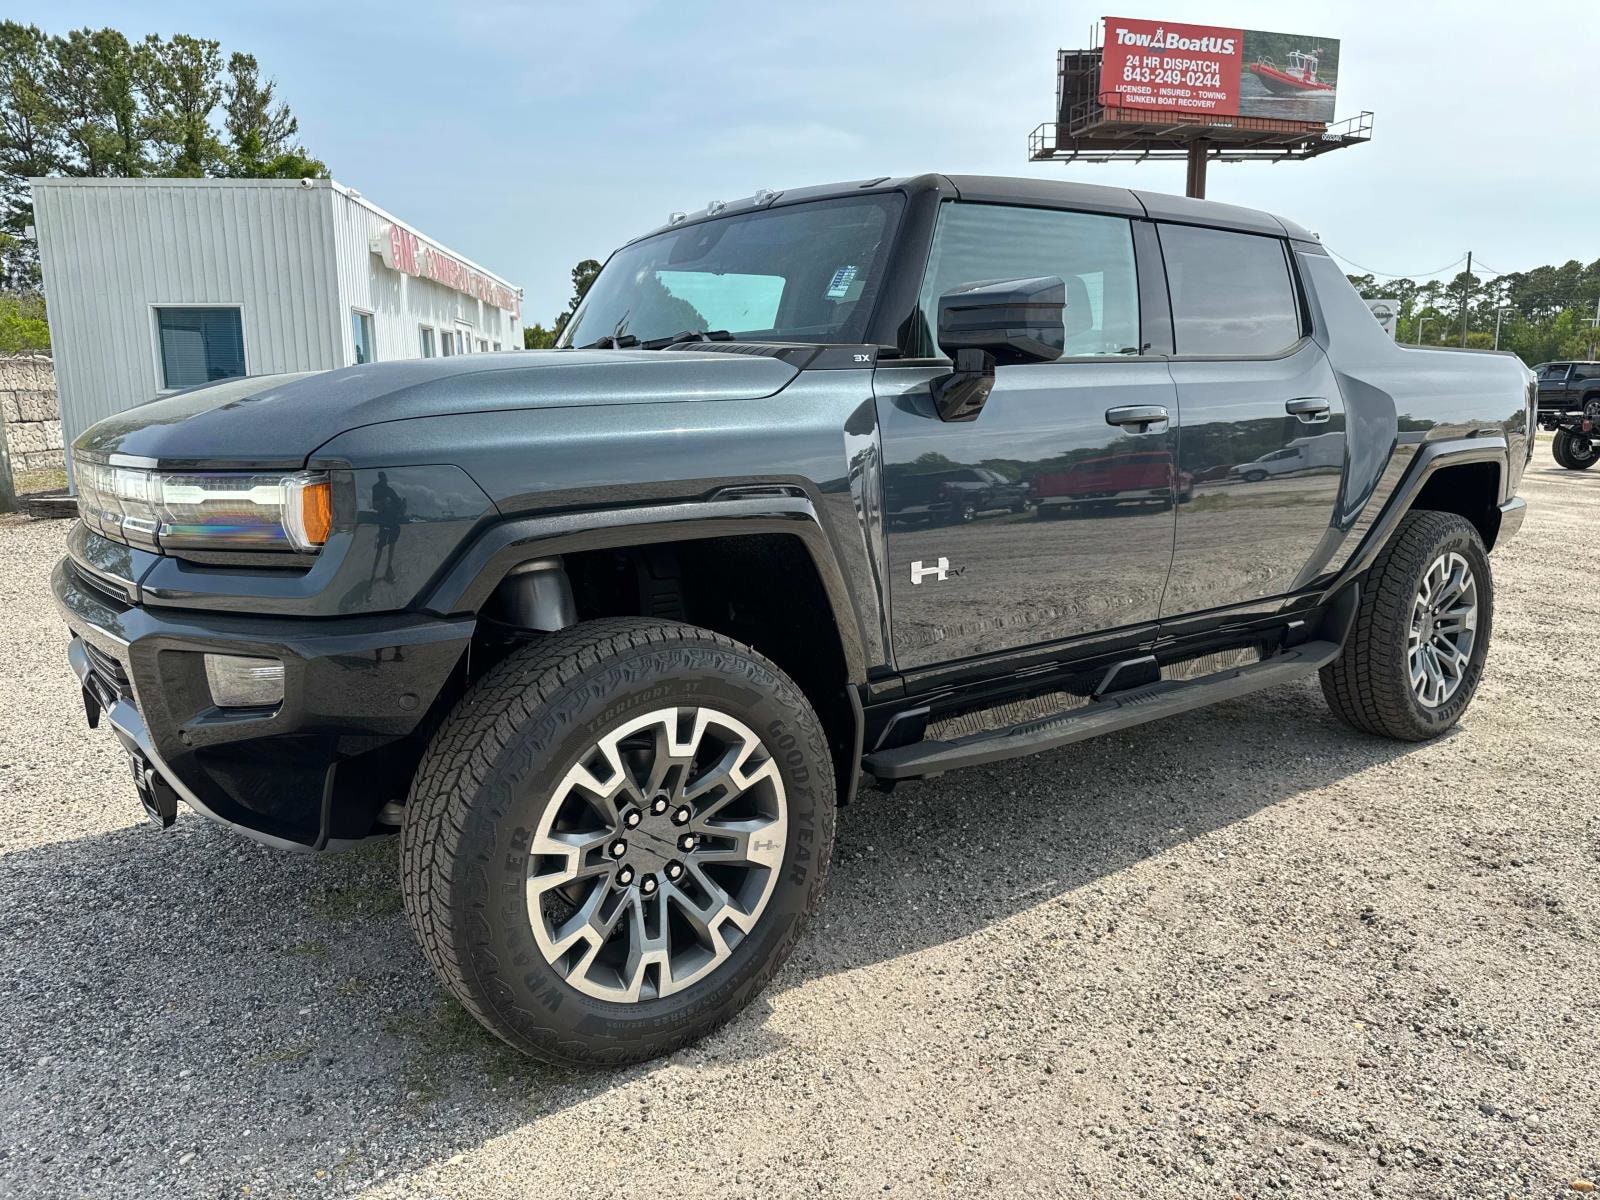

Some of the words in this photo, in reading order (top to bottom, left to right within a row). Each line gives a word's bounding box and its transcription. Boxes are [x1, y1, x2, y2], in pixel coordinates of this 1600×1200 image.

[1126, 55, 1140, 66] 24
[1143, 56, 1160, 69] HR
[1163, 58, 1219, 73] DISPATCH
[1123, 67, 1221, 88] 843-249-0244
[1115, 85, 1152, 94] LICENSED
[1159, 88, 1191, 97] INSURED
[1198, 91, 1226, 100] TOWING
[1126, 95, 1156, 104] SUNKEN
[1158, 97, 1177, 105] BOAT
[1178, 98, 1216, 108] RECOVERY
[390, 224, 421, 278] GMC
[853, 354, 871, 362] 3X
